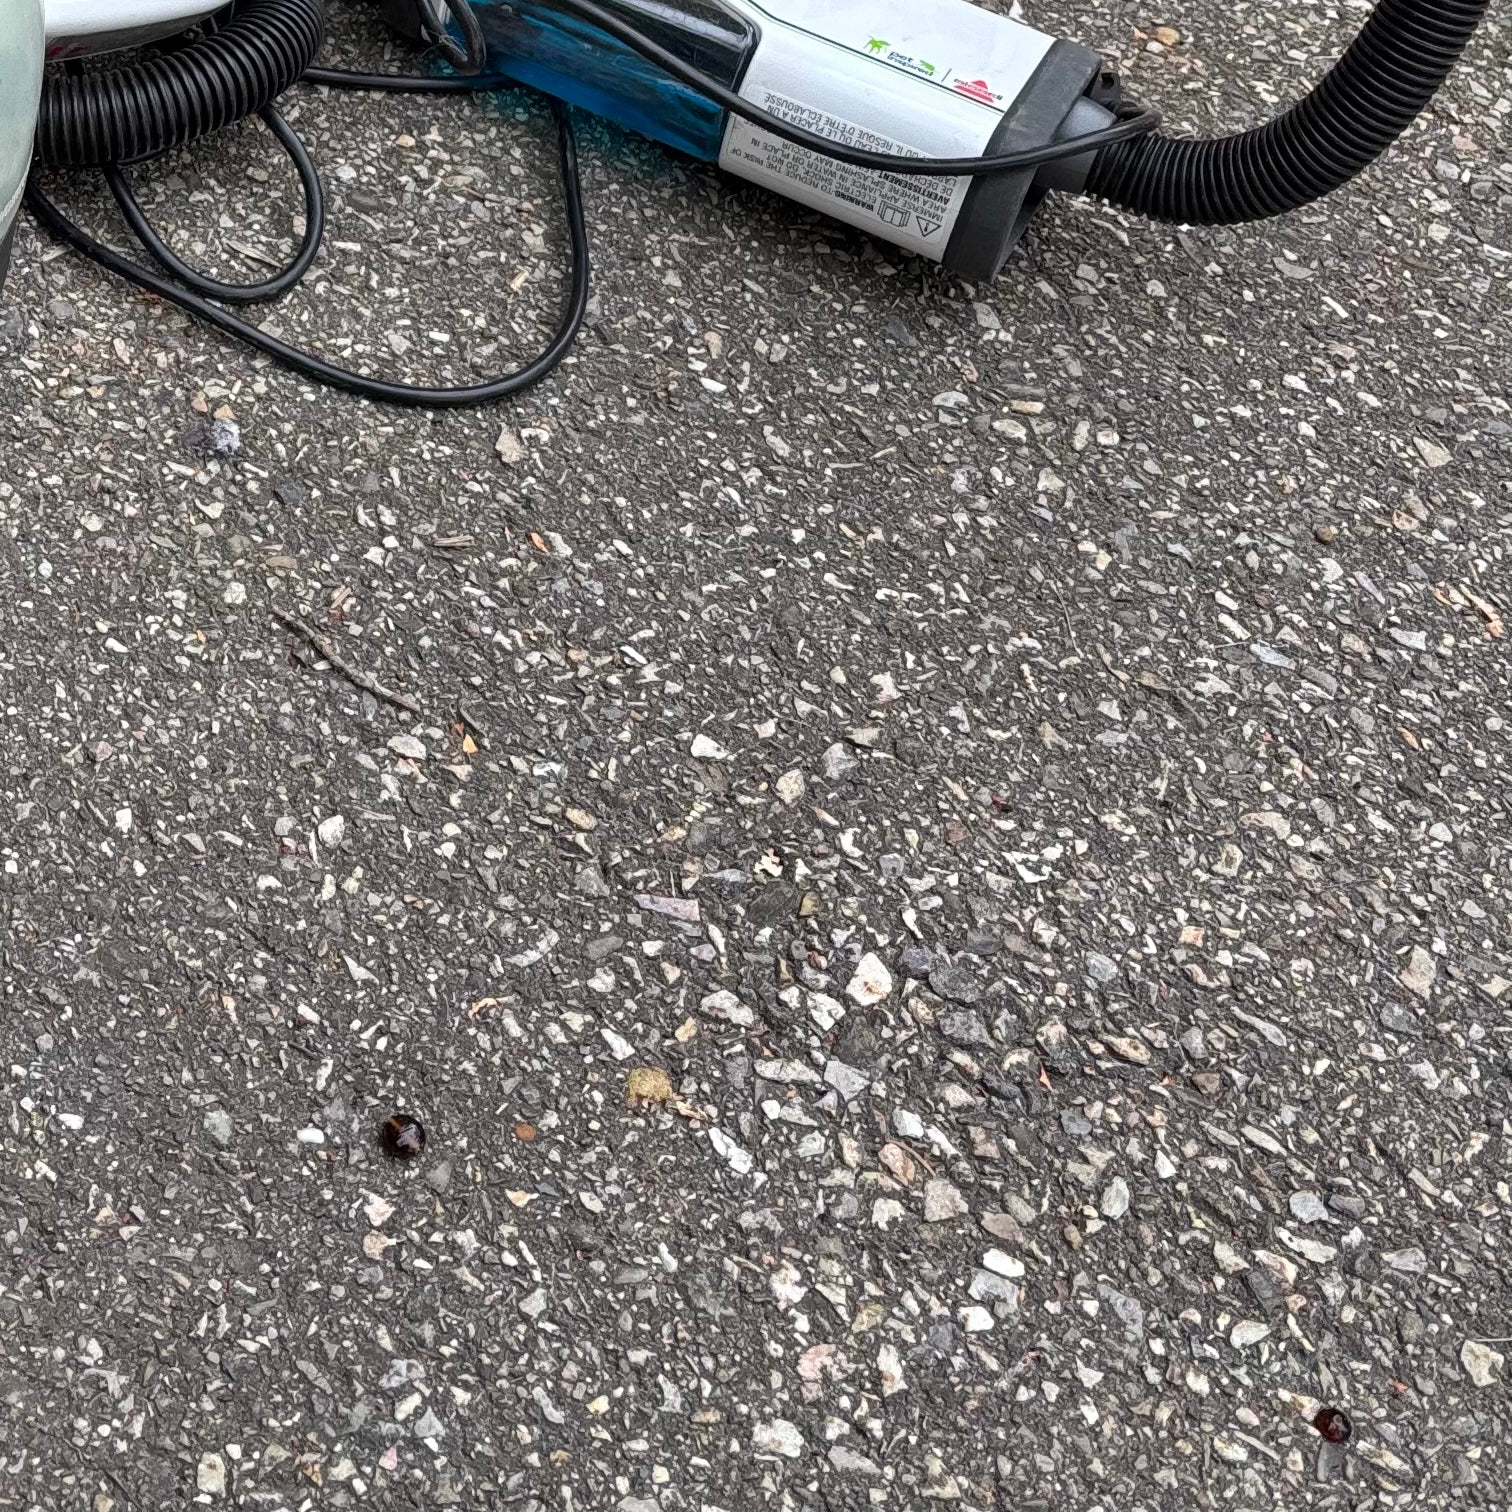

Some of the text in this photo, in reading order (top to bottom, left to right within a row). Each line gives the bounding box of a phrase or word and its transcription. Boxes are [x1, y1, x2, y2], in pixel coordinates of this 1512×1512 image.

[785, 160, 799, 172] DO
[790, 154, 805, 165] OR
[812, 153, 833, 167] MAY
[805, 160, 837, 179] WATER
[837, 173, 849, 183] IN
[833, 180, 877, 204] ELECTRIC
[849, 178, 900, 205] APPLIANCE
[886, 183, 921, 204] WHERE
[921, 197, 947, 214] AREA
